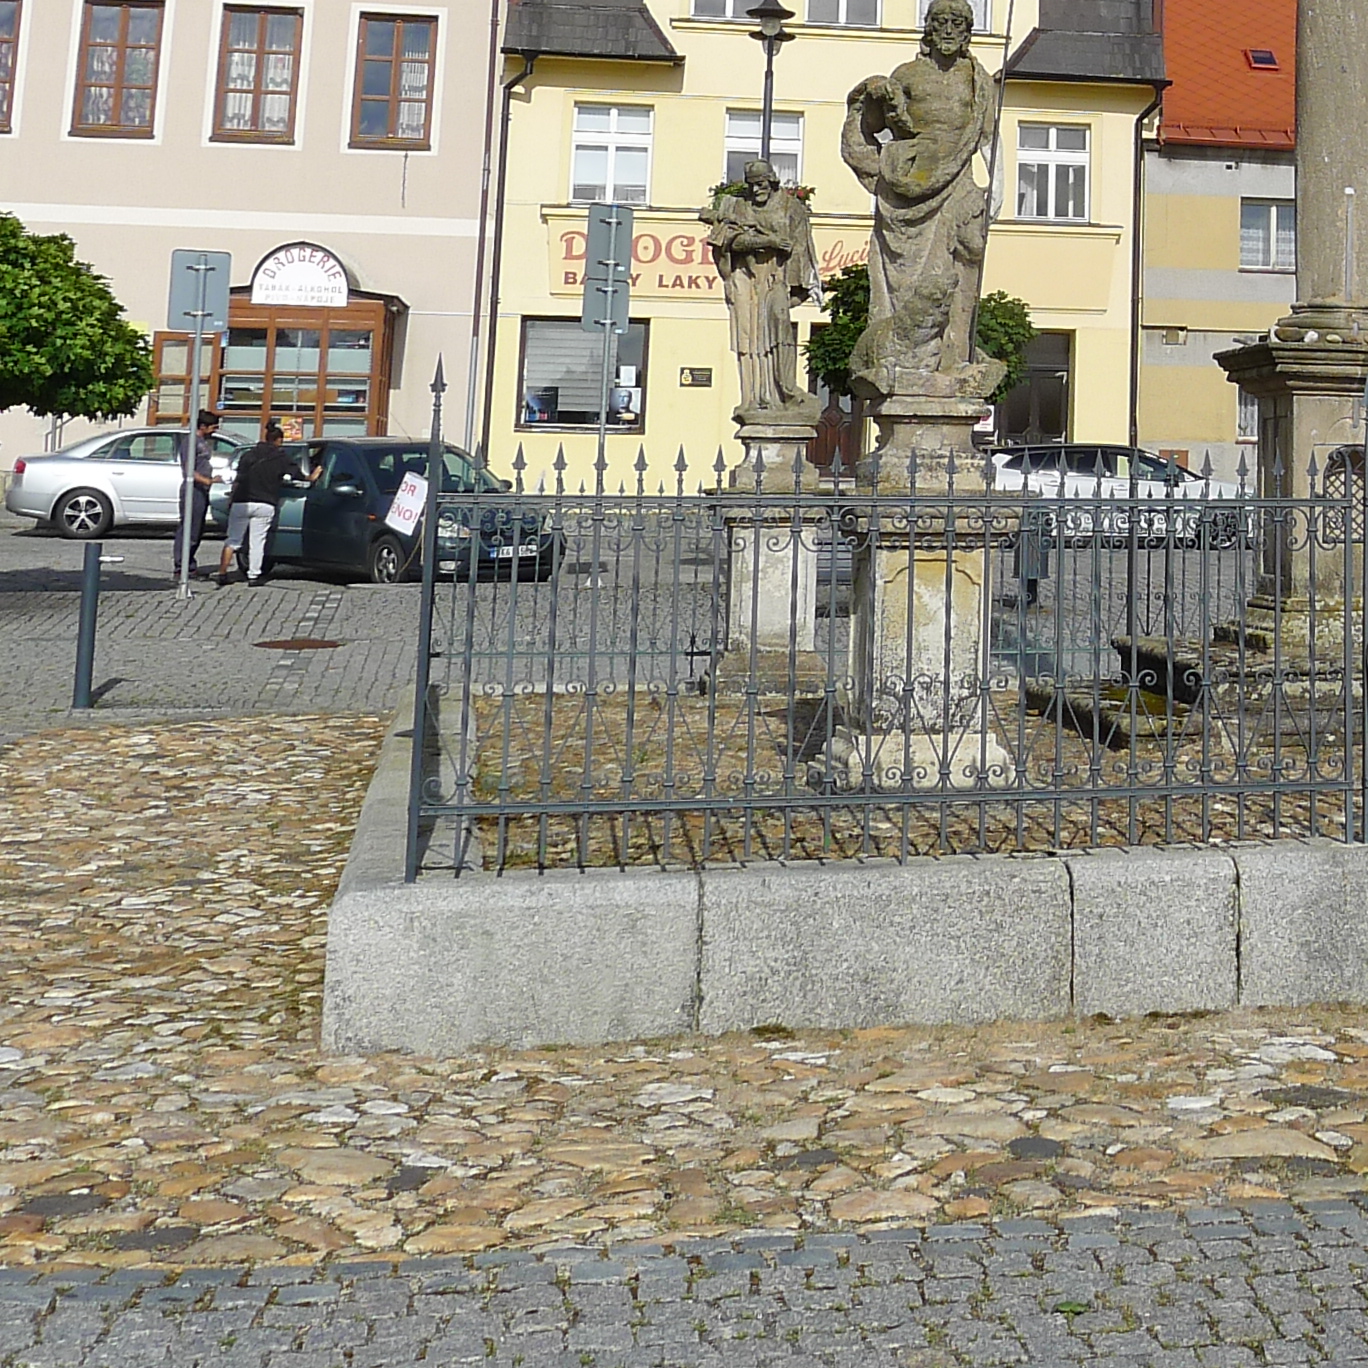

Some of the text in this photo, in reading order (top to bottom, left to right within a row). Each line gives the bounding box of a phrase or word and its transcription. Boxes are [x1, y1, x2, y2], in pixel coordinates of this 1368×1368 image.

[262, 246, 342, 283] DROGERIE
[819, 240, 870, 274] Luci
[657, 273, 718, 290] LAKY
